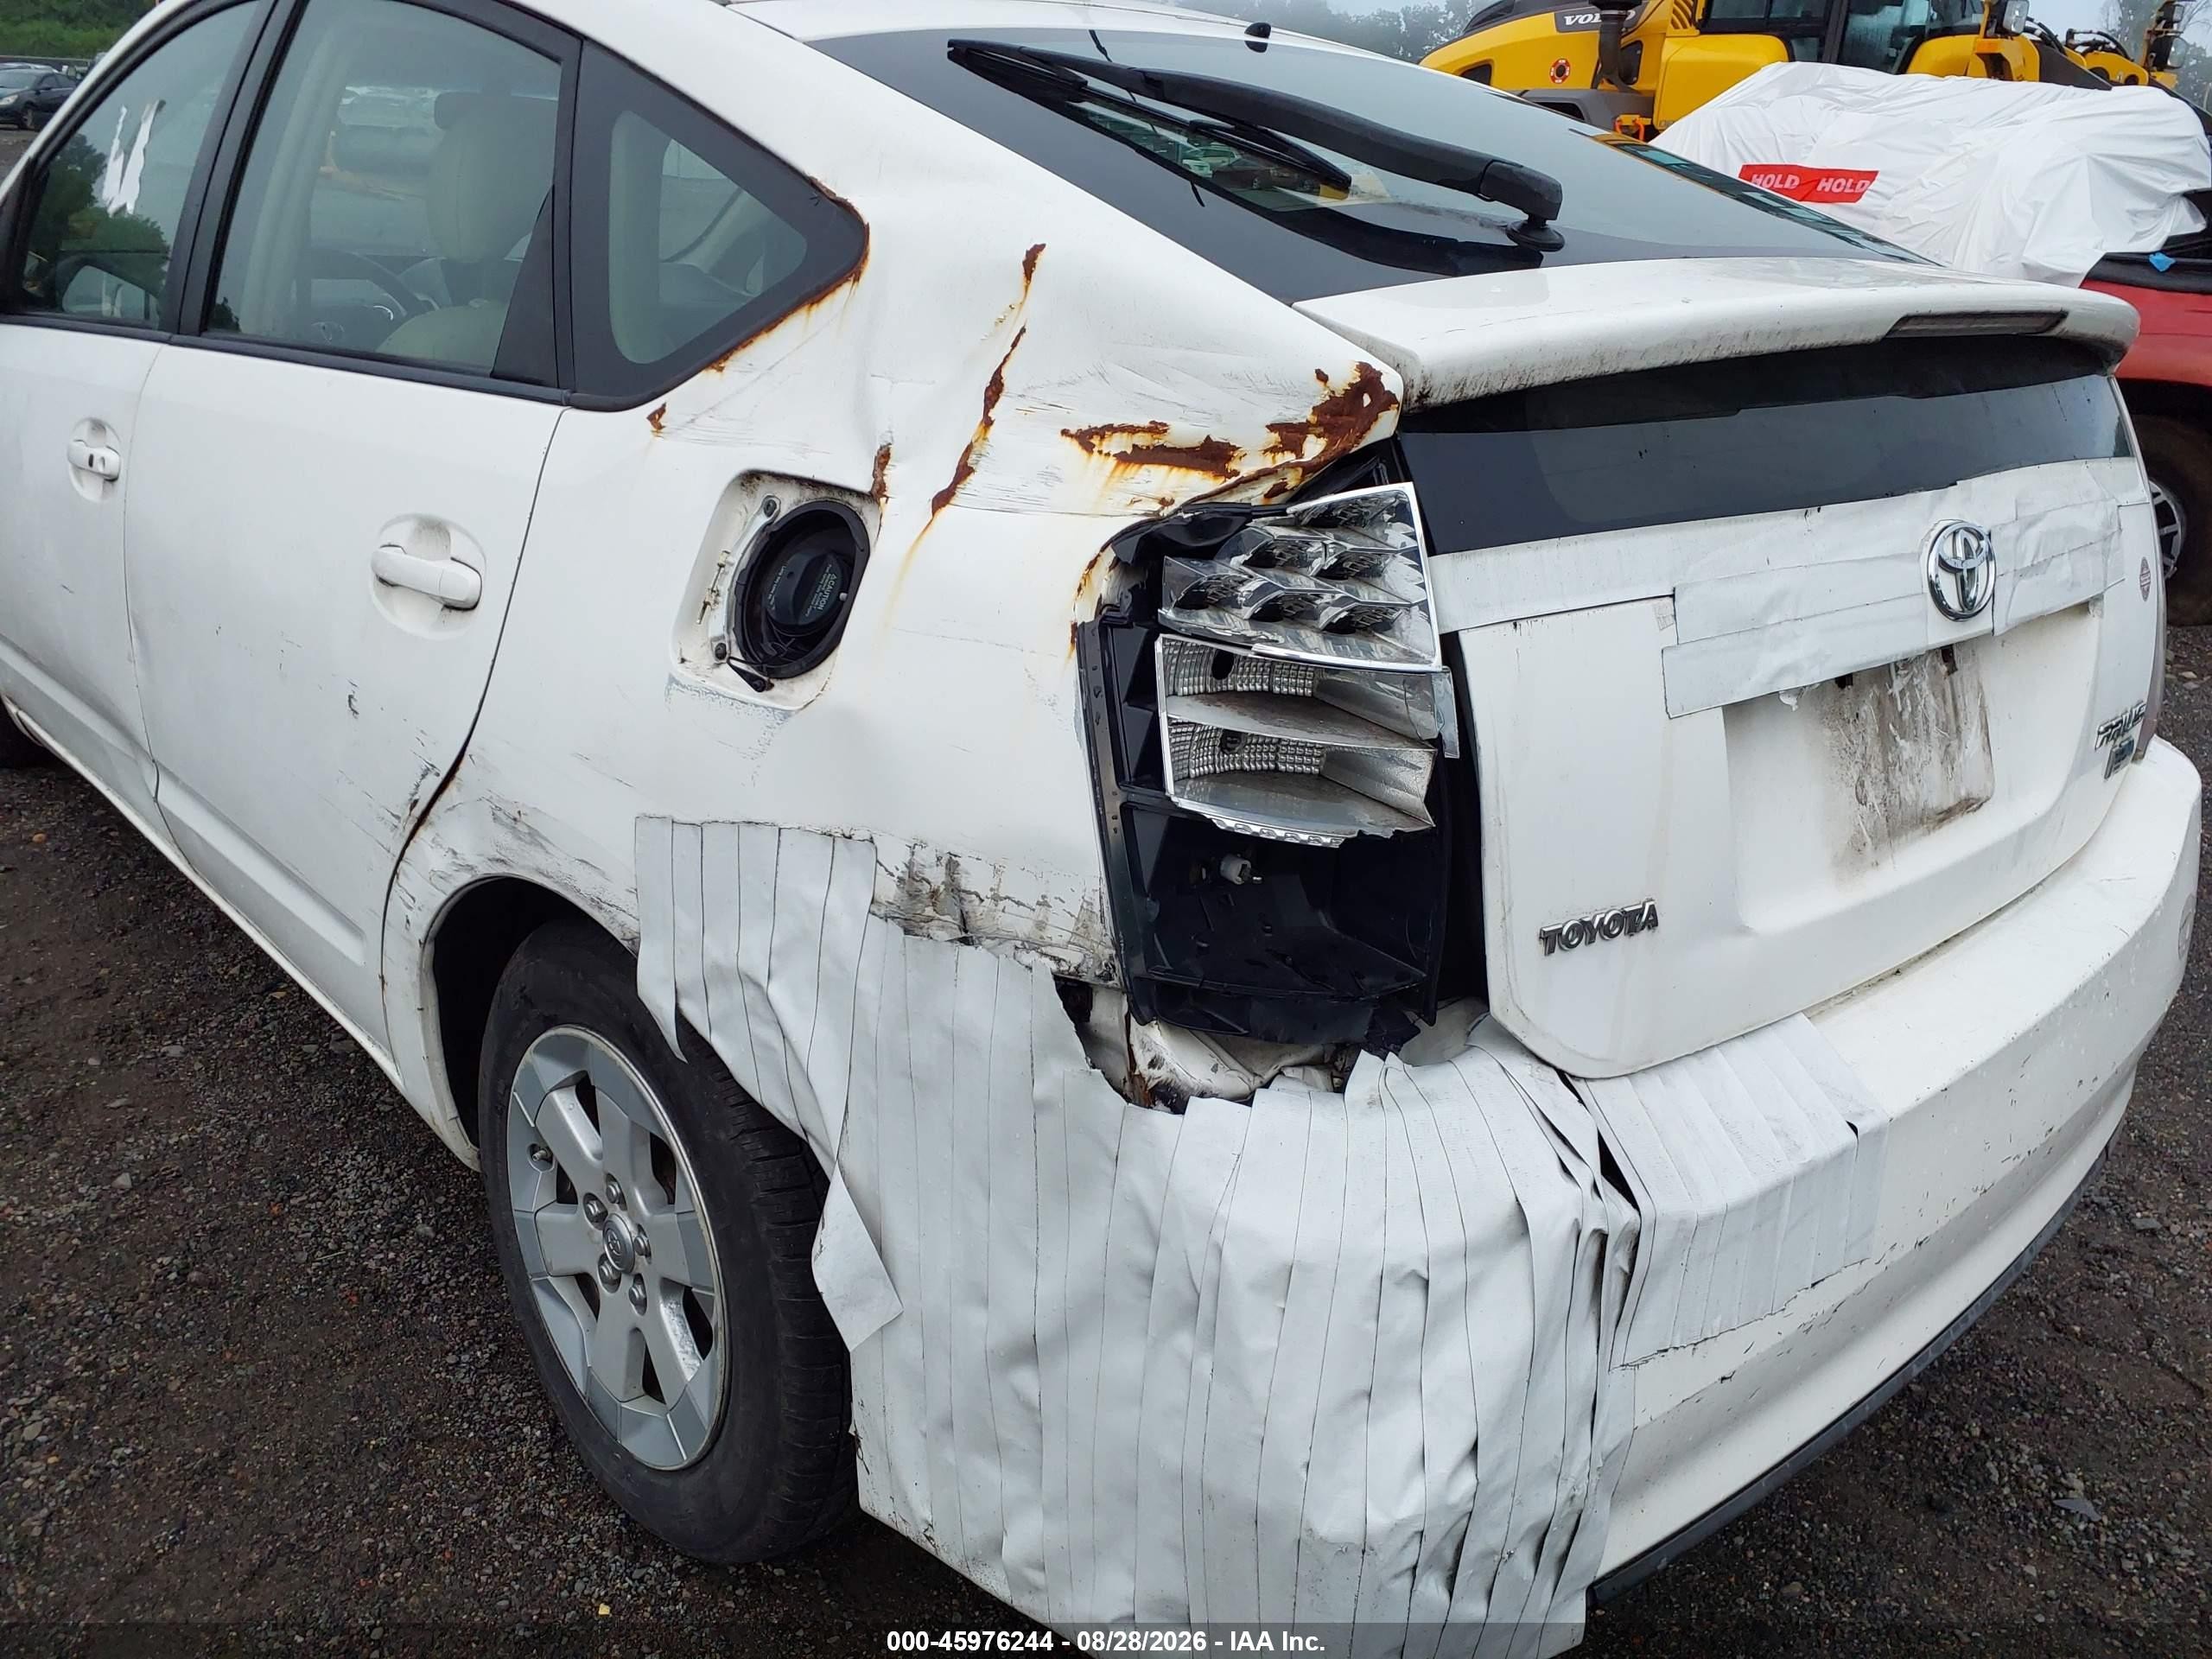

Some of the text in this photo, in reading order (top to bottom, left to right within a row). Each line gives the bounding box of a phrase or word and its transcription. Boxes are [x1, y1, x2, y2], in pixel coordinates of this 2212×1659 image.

[1564, 10, 1636, 25] VOLO
[1751, 174, 1871, 193] HOLD HOLD
[817, 579, 835, 610] CAUTION
[1539, 898, 1659, 956] TOYOTA
